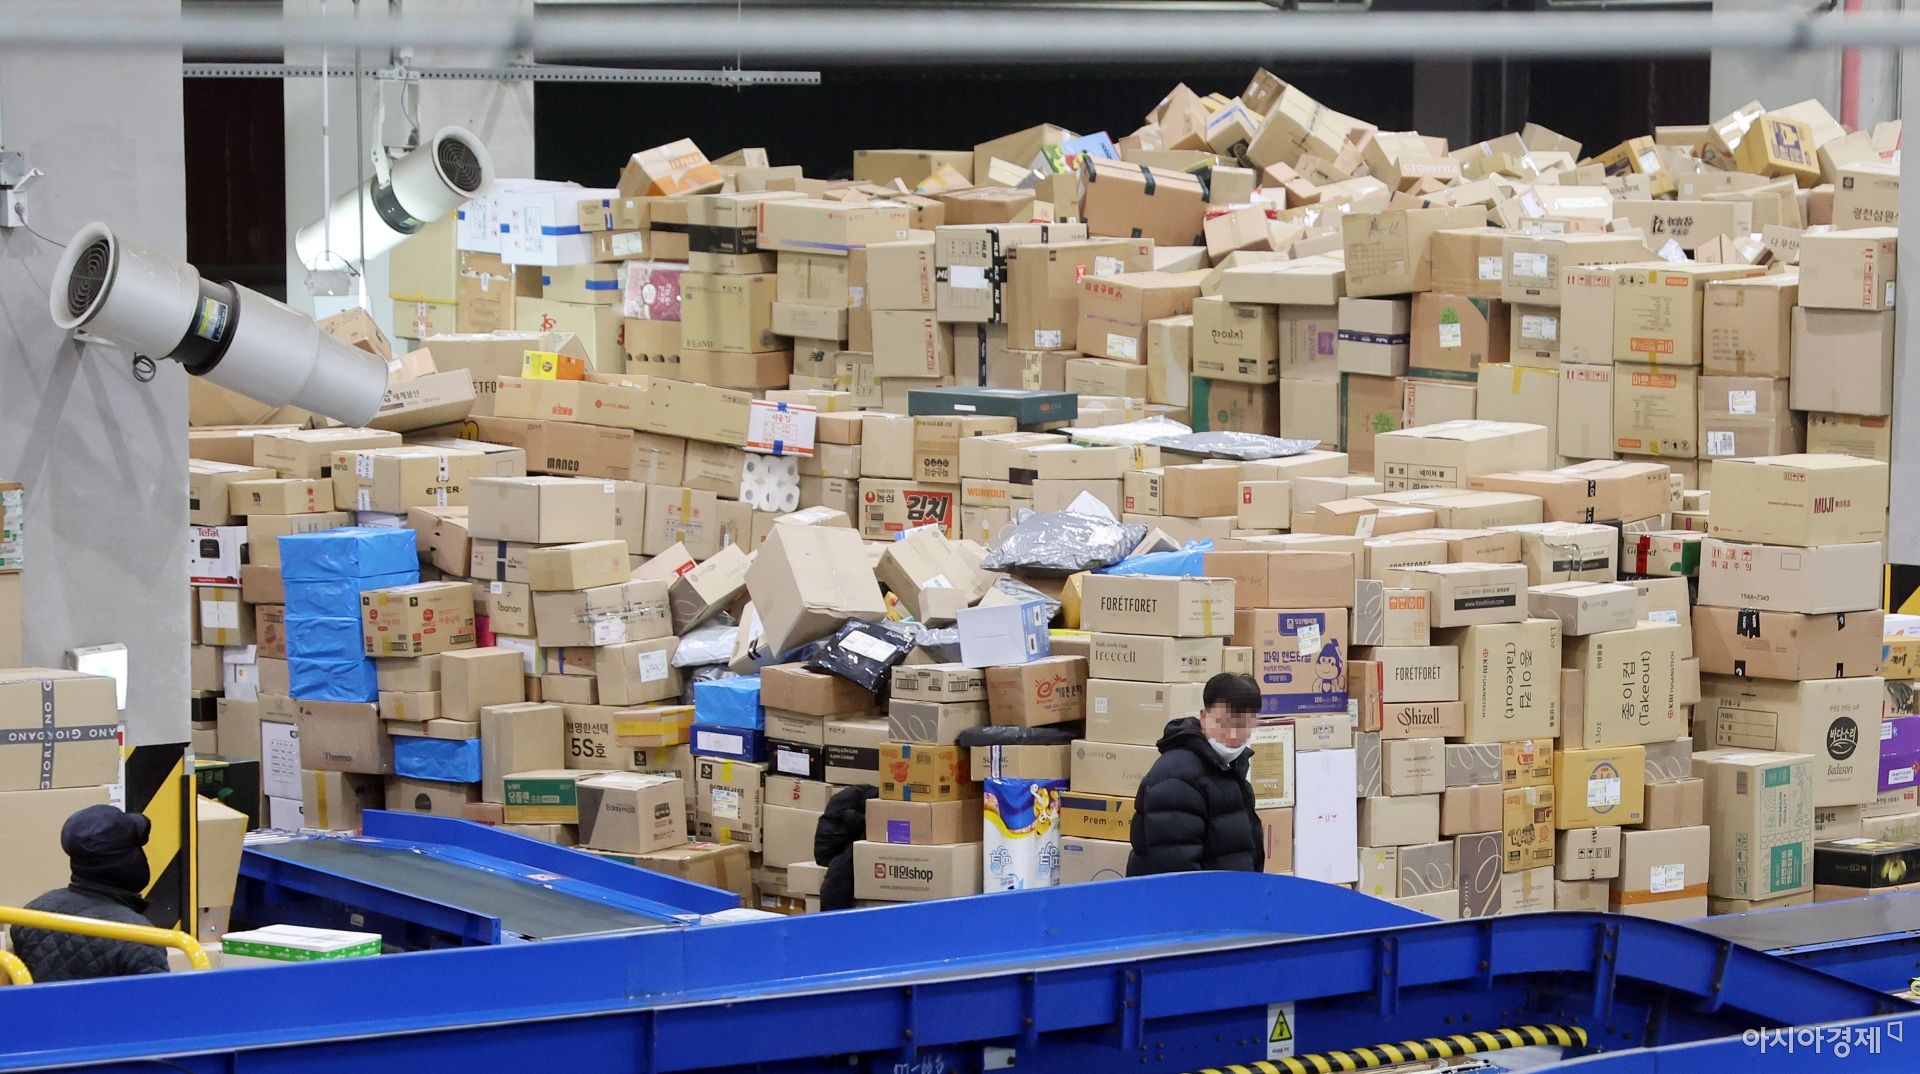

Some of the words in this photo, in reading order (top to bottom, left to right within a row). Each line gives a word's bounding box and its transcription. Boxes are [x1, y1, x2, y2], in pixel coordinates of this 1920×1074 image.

[547, 457, 579, 472] MANGO
[877, 494, 894, 503] 농심
[967, 488, 1006, 498] WORKOUT
[907, 496, 947, 522] 김치
[1814, 497, 1834, 514] MUJI
[197, 528, 220, 538] Tefal
[1264, 652, 1280, 663] 파워
[1504, 641, 1517, 720] (Takeout)
[1519, 649, 1533, 709] 종이컵
[1621, 661, 1636, 720] 종이컵
[1638, 650, 1651, 727] (Takeout)
[1397, 707, 1440, 733] Shizell
[1829, 726, 1857, 741] 바다소리
[571, 738, 607, 758] 5S호
